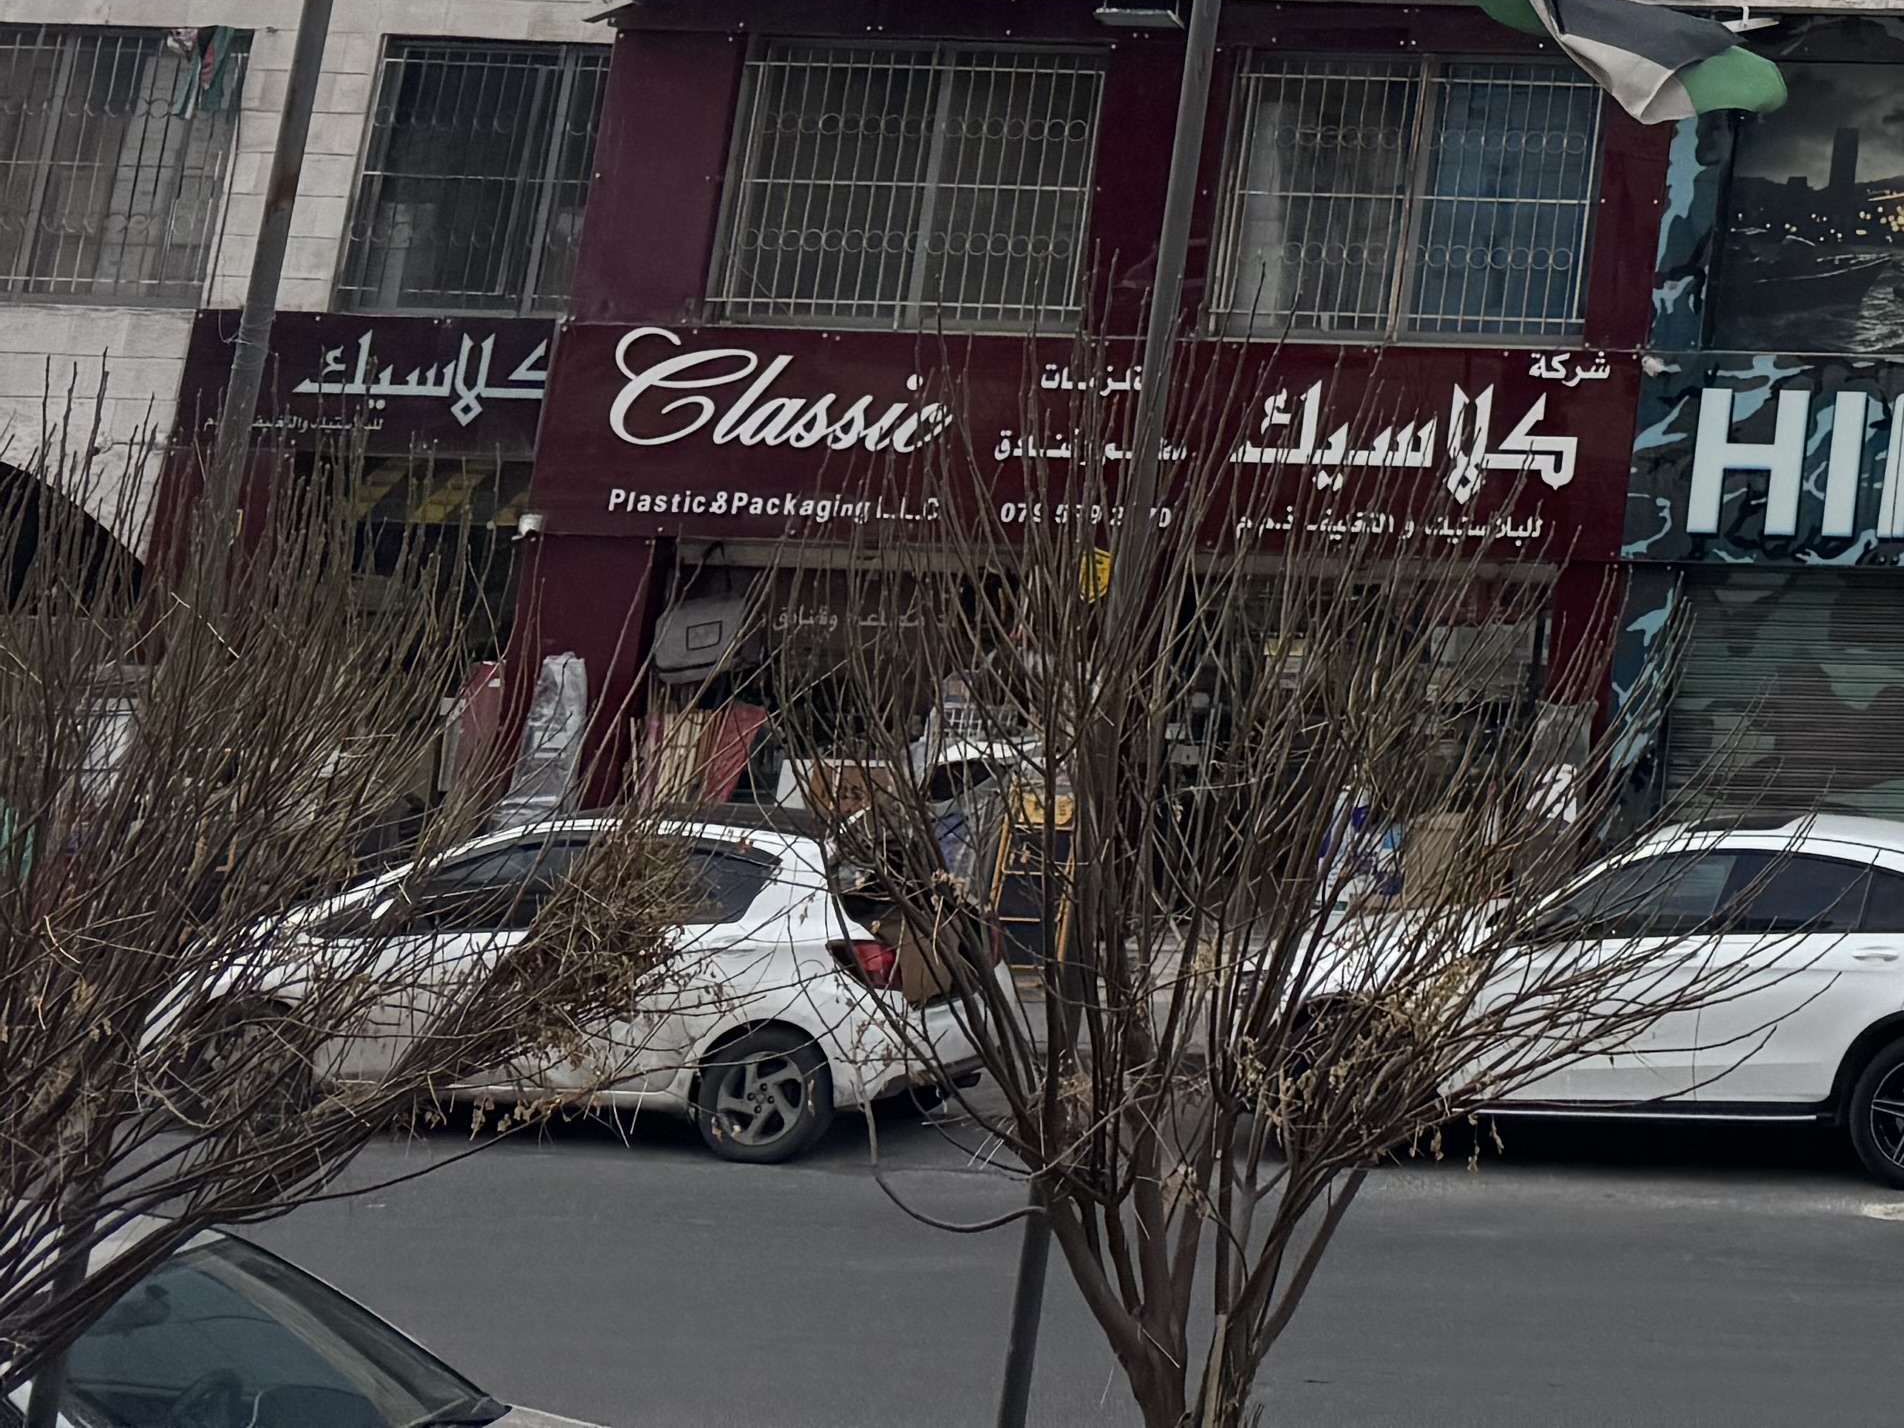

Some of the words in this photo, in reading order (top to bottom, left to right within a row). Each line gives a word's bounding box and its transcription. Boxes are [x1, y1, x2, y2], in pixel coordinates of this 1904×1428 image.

[608, 327, 953, 453] Classic
[1529, 351, 1611, 387] شركة
[1230, 380, 1578, 505] كلاسيك
